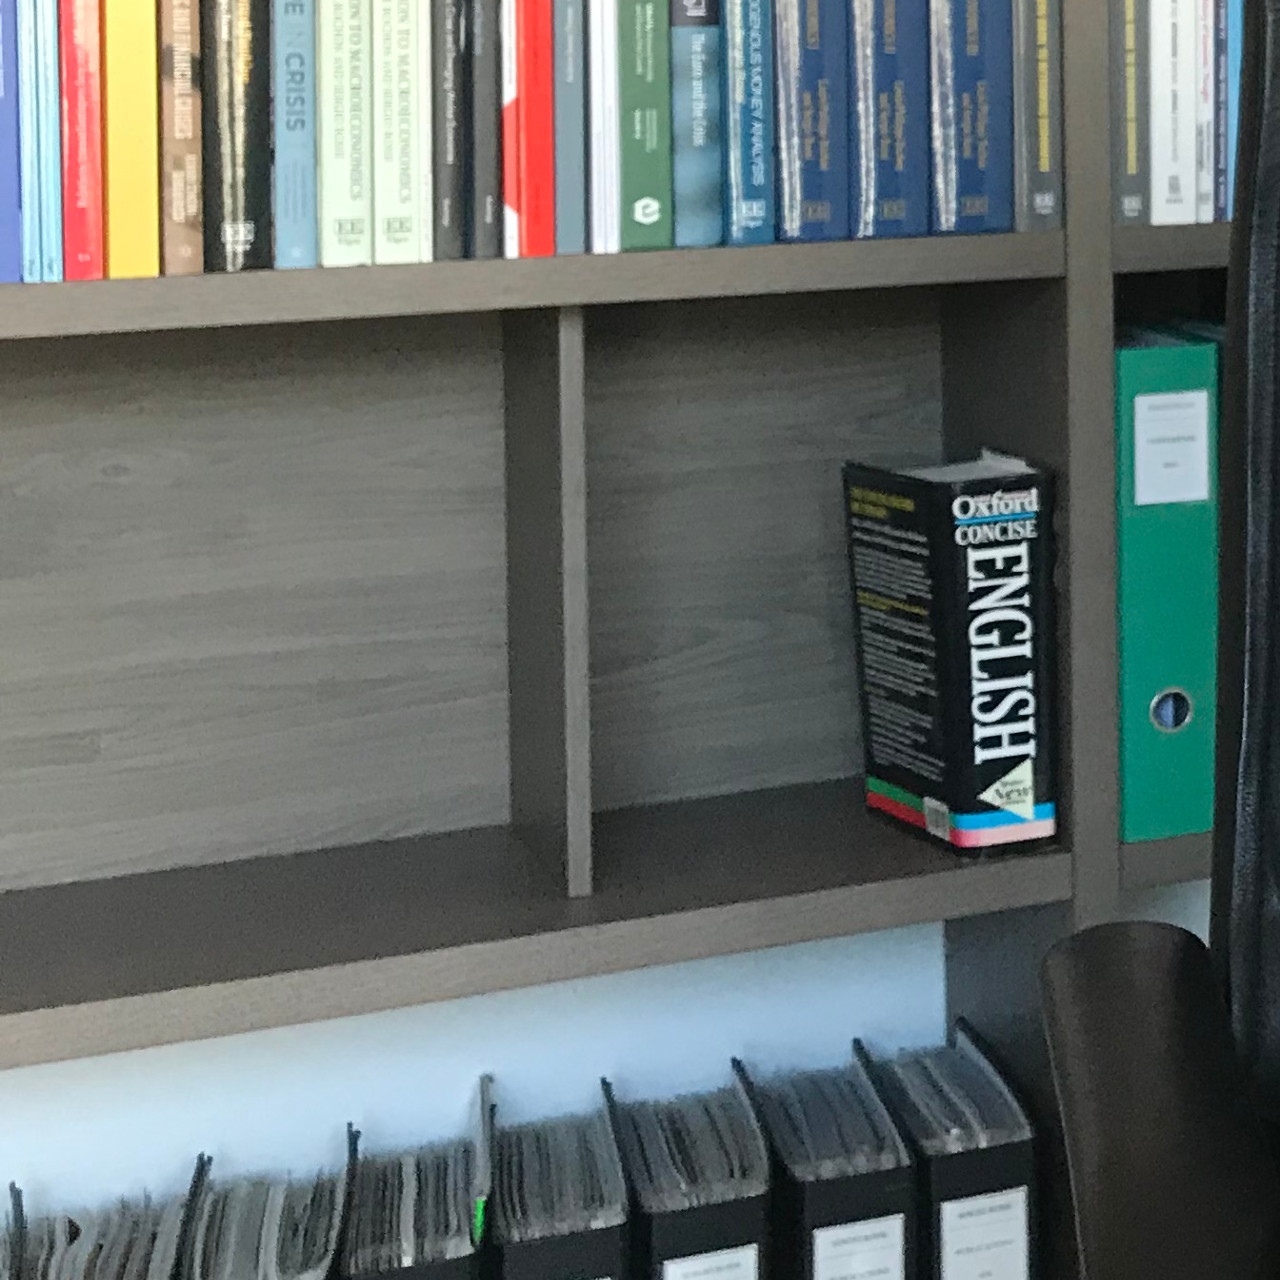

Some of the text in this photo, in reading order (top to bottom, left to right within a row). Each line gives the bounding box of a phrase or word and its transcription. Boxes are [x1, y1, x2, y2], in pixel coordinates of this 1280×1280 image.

[172, 7, 192, 33] AND
[349, 23, 363, 47] TO
[396, 27, 412, 50] TO
[172, 33, 193, 95] FINANCIAL
[284, 51, 307, 132] CRISIS
[690, 33, 707, 146] The Euro and the Crisis
[749, 64, 763, 120] MONEY
[173, 95, 194, 140] CRISES
[348, 47, 364, 203] MACROECONOMICS
[397, 52, 413, 205] MACROECONOMICS
[750, 120, 765, 186] ANALYSIS
[951, 486, 1039, 520] Oxford
[954, 519, 1038, 546] CONCISE
[967, 540, 1037, 766] ENGLISH
